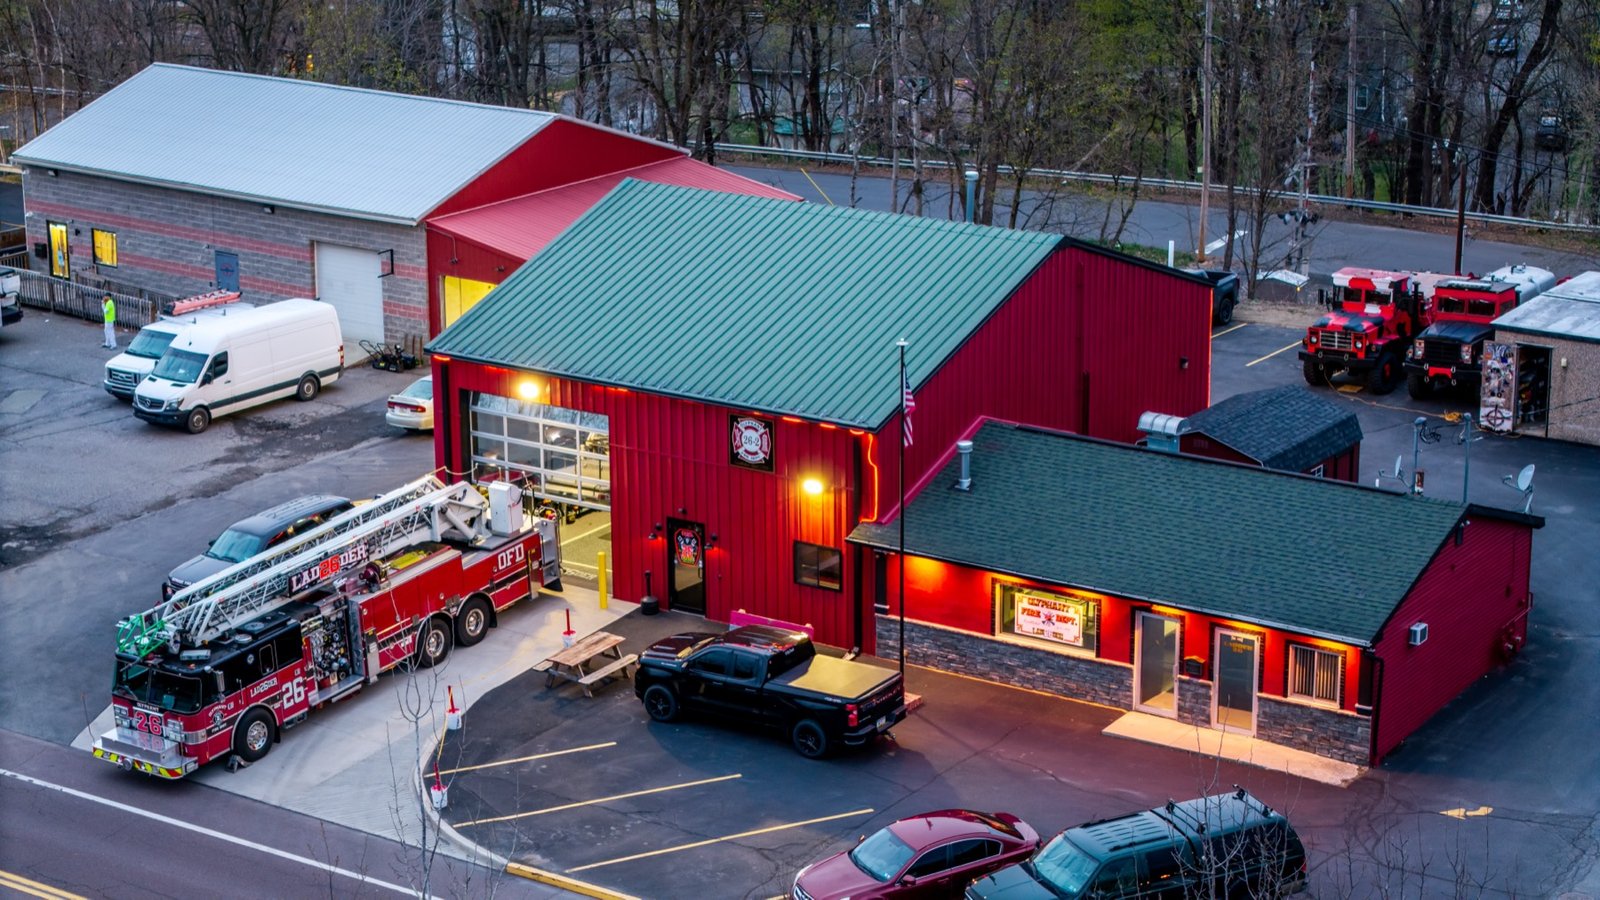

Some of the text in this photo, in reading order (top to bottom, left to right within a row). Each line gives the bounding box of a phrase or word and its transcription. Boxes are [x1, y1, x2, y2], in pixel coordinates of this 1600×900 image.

[743, 435, 760, 447] 26-2
[497, 543, 525, 571] OFD
[1021, 606, 1041, 618] FIRE
[281, 676, 306, 710] 26
[134, 711, 162, 735] 26
